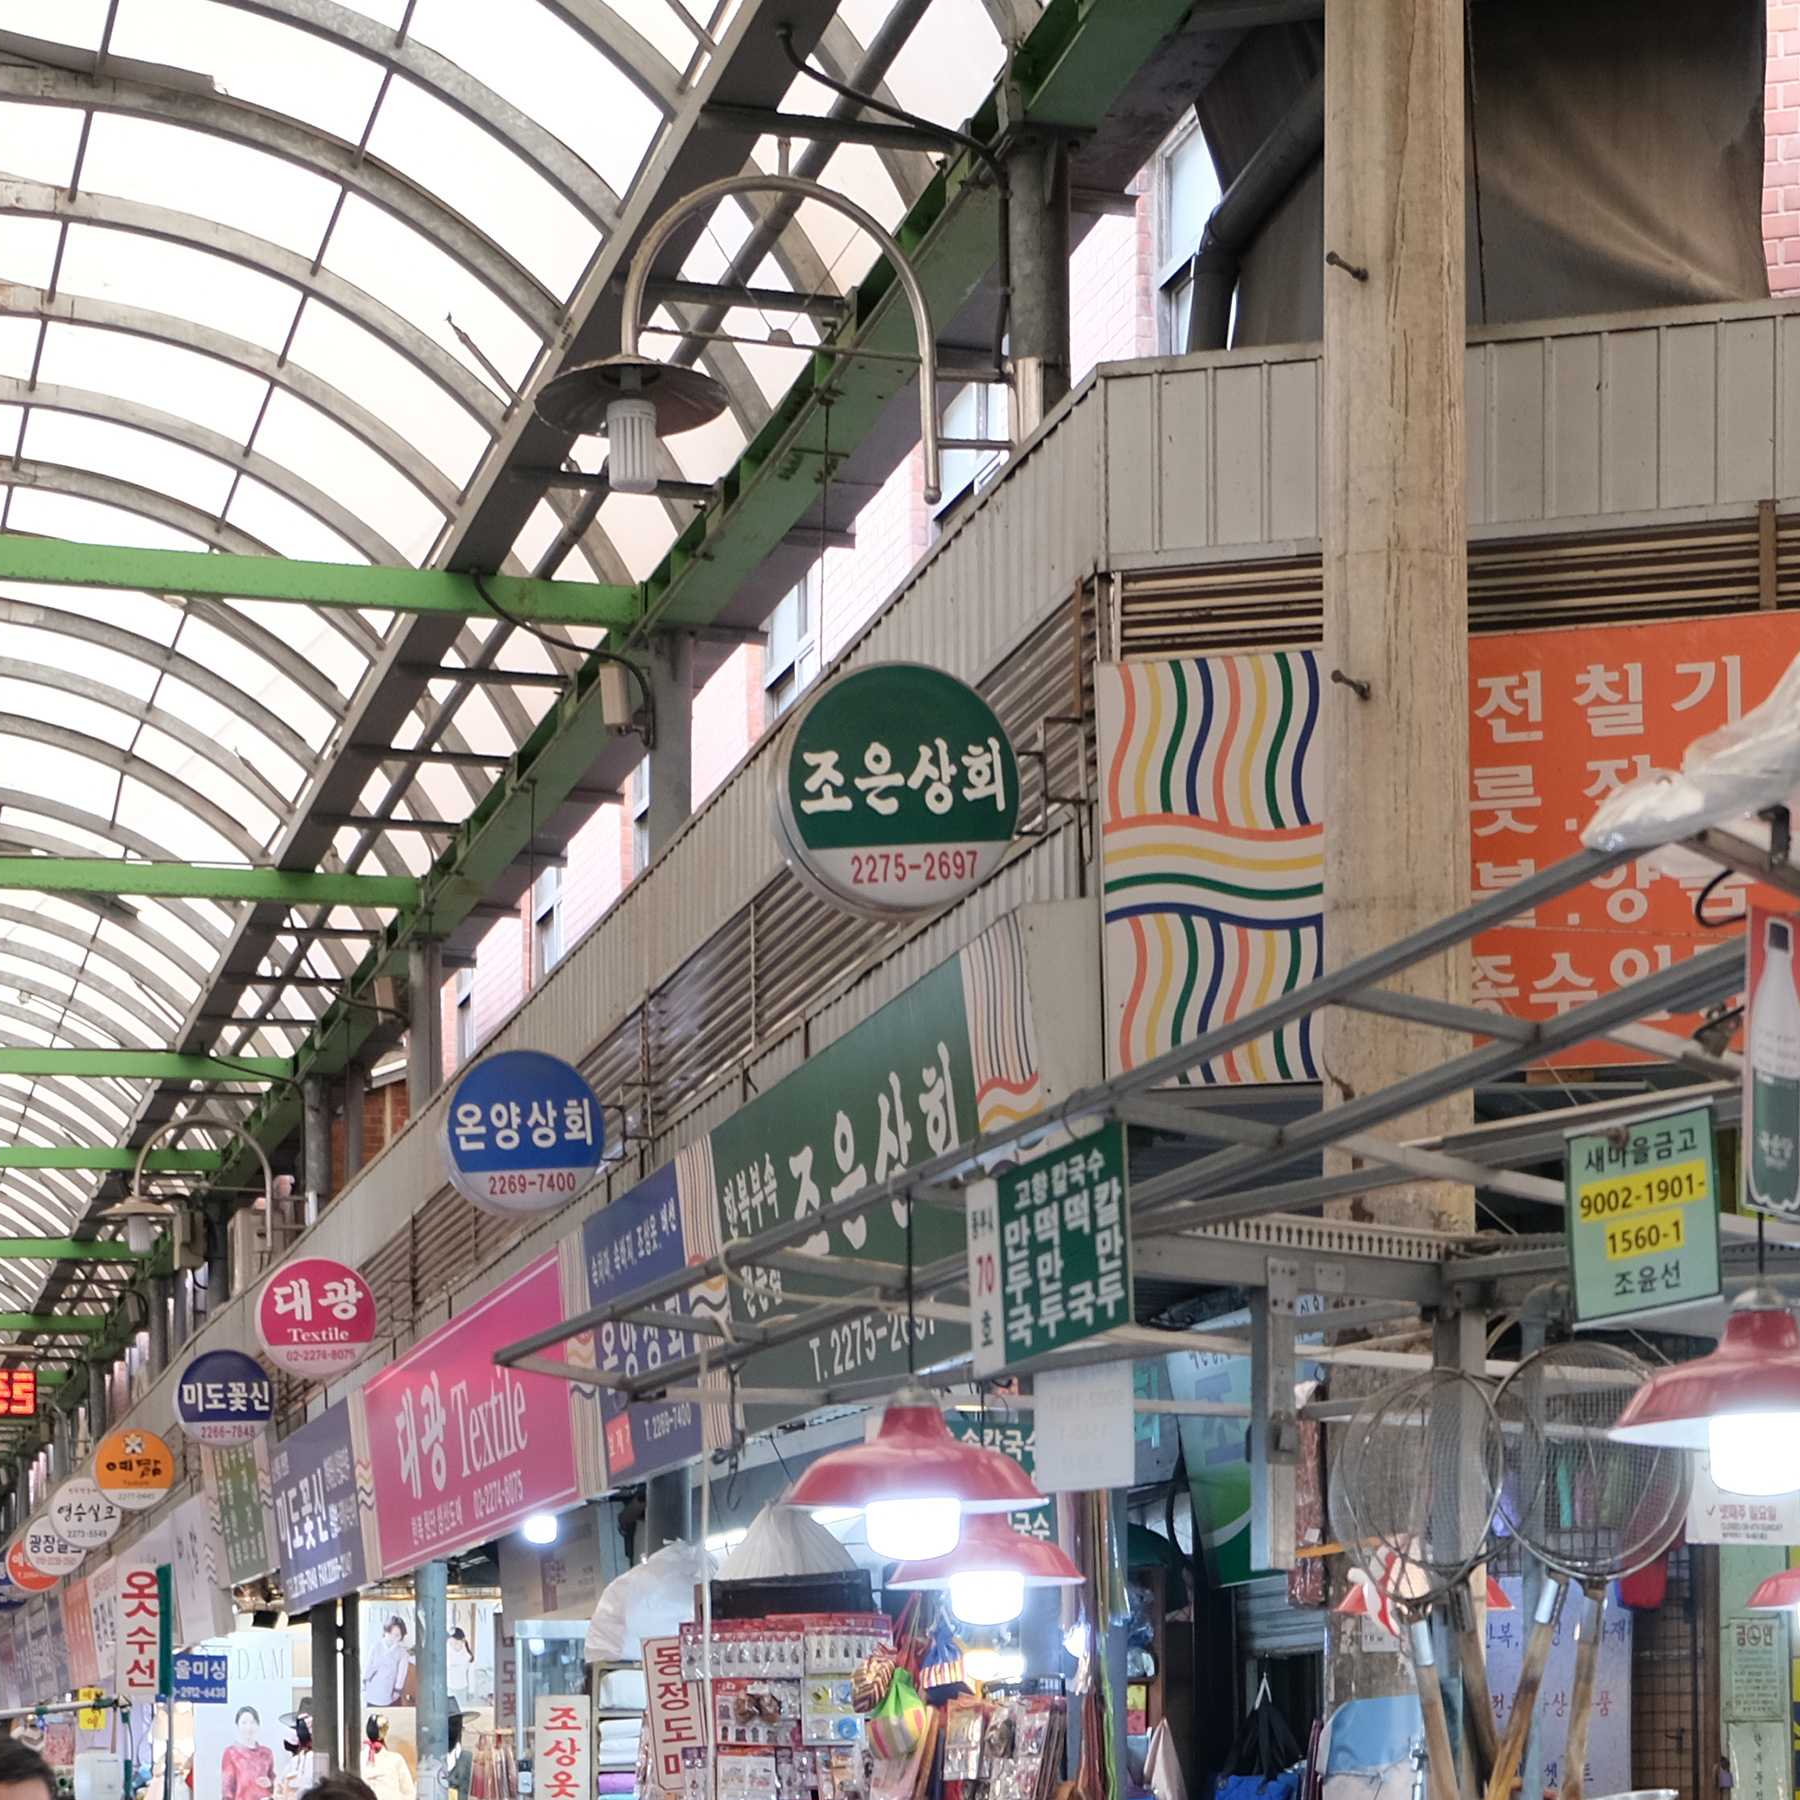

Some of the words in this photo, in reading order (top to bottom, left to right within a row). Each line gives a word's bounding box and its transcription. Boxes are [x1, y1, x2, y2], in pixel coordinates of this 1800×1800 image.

[800, 736, 1007, 815] 조은상회
[850, 851, 979, 885] 2275-2697
[454, 1097, 593, 1153] 온양상회
[1586, 1127, 1698, 1172] 새마을금고
[488, 1173, 577, 1195] 2269-7400
[724, 1153, 779, 1241] 한복부속
[1579, 1172, 1705, 1219] 9002-1901-
[1607, 1219, 1683, 1257] 1560-1
[976, 1254, 994, 1296] 70
[1614, 1261, 1682, 1297] 조윤선
[273, 1278, 364, 1321] 대광
[287, 1328, 350, 1343] Textile
[287, 1349, 356, 1361] 02-2274-8075
[182, 1381, 270, 1413] 미도꽃신
[395, 1370, 446, 1500] 대광
[450, 1365, 528, 1478] Textile
[122, 1571, 159, 1687] 옷수선
[174, 1659, 226, 1681] 울미싱
[543, 1707, 582, 1798] 조상옷
